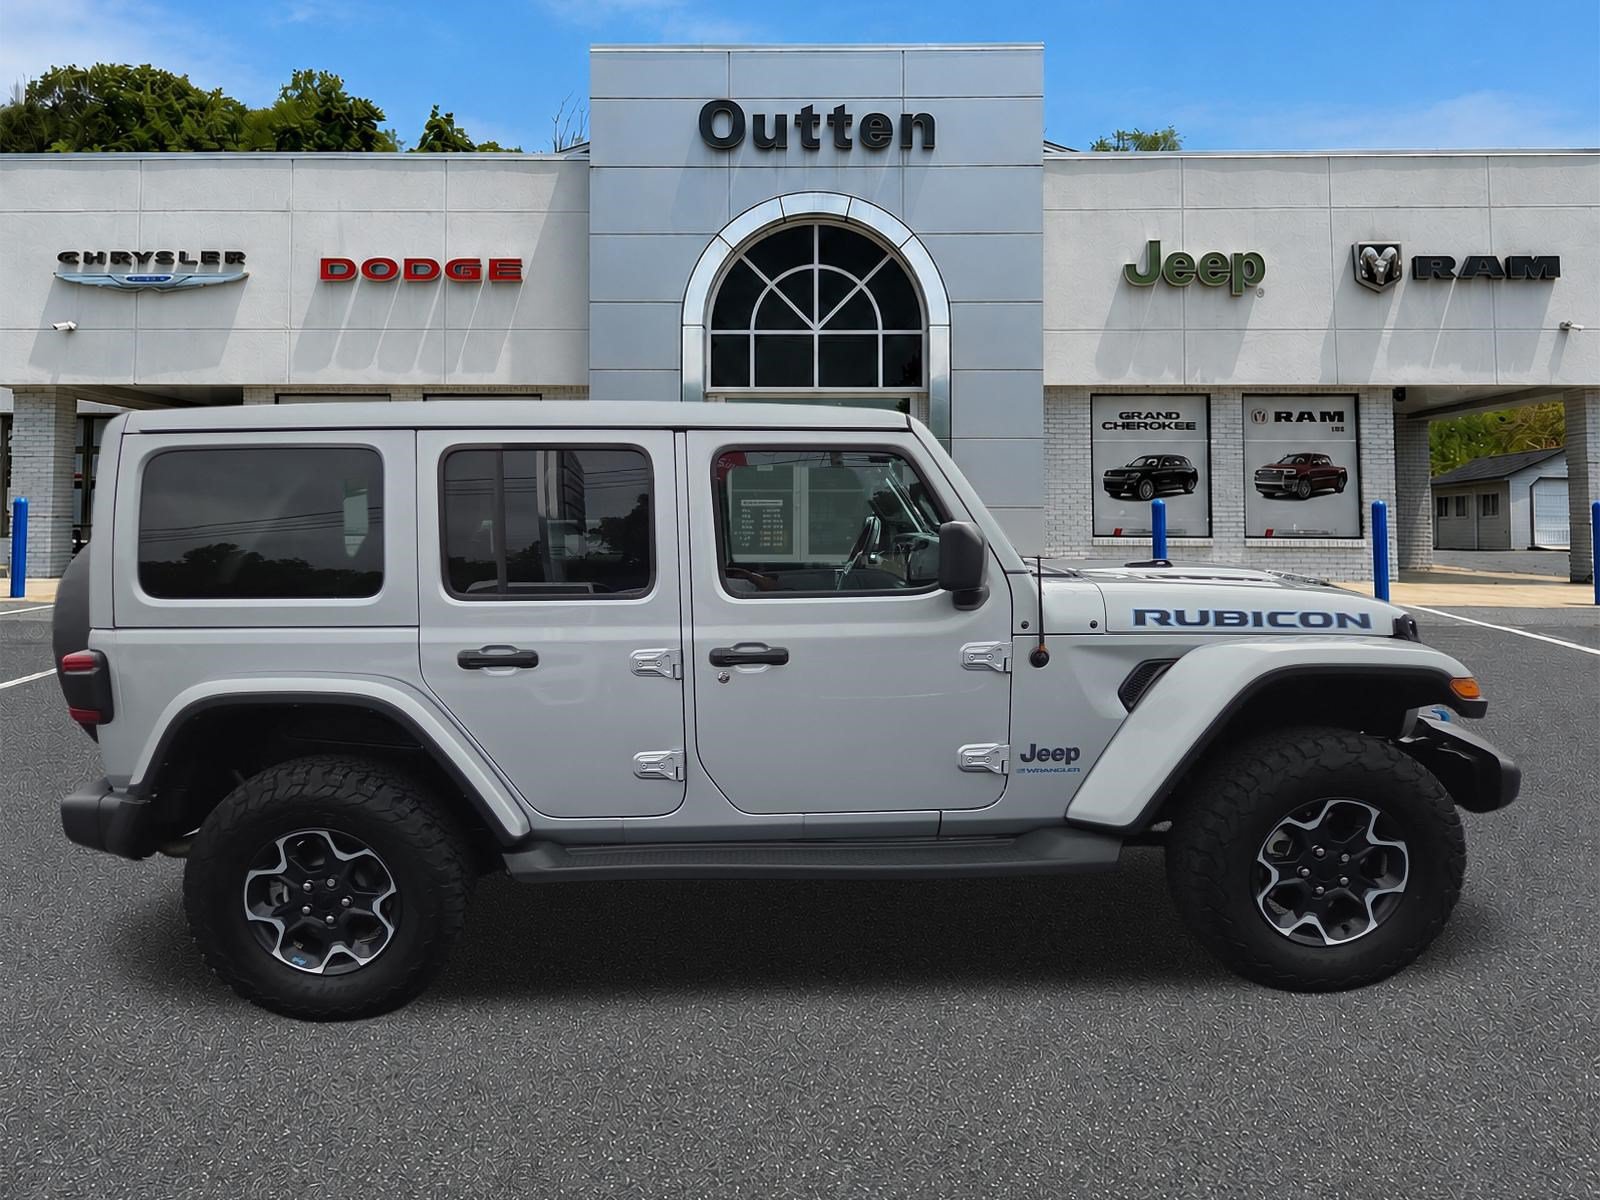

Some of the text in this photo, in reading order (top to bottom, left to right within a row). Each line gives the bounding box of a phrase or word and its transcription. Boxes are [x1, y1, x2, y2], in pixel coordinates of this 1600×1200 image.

[699, 99, 936, 149] Outten
[57, 250, 246, 266] CHRYSLER
[1123, 239, 1266, 296] Jeep
[1412, 256, 1561, 280] RAM
[320, 257, 523, 282] DODGE
[1102, 421, 1196, 430] CHEROKEE
[1119, 411, 1180, 420] GRAND
[1274, 411, 1344, 422] RAM
[1132, 608, 1372, 629] RUBICON
[1020, 743, 1080, 765] Jeep
